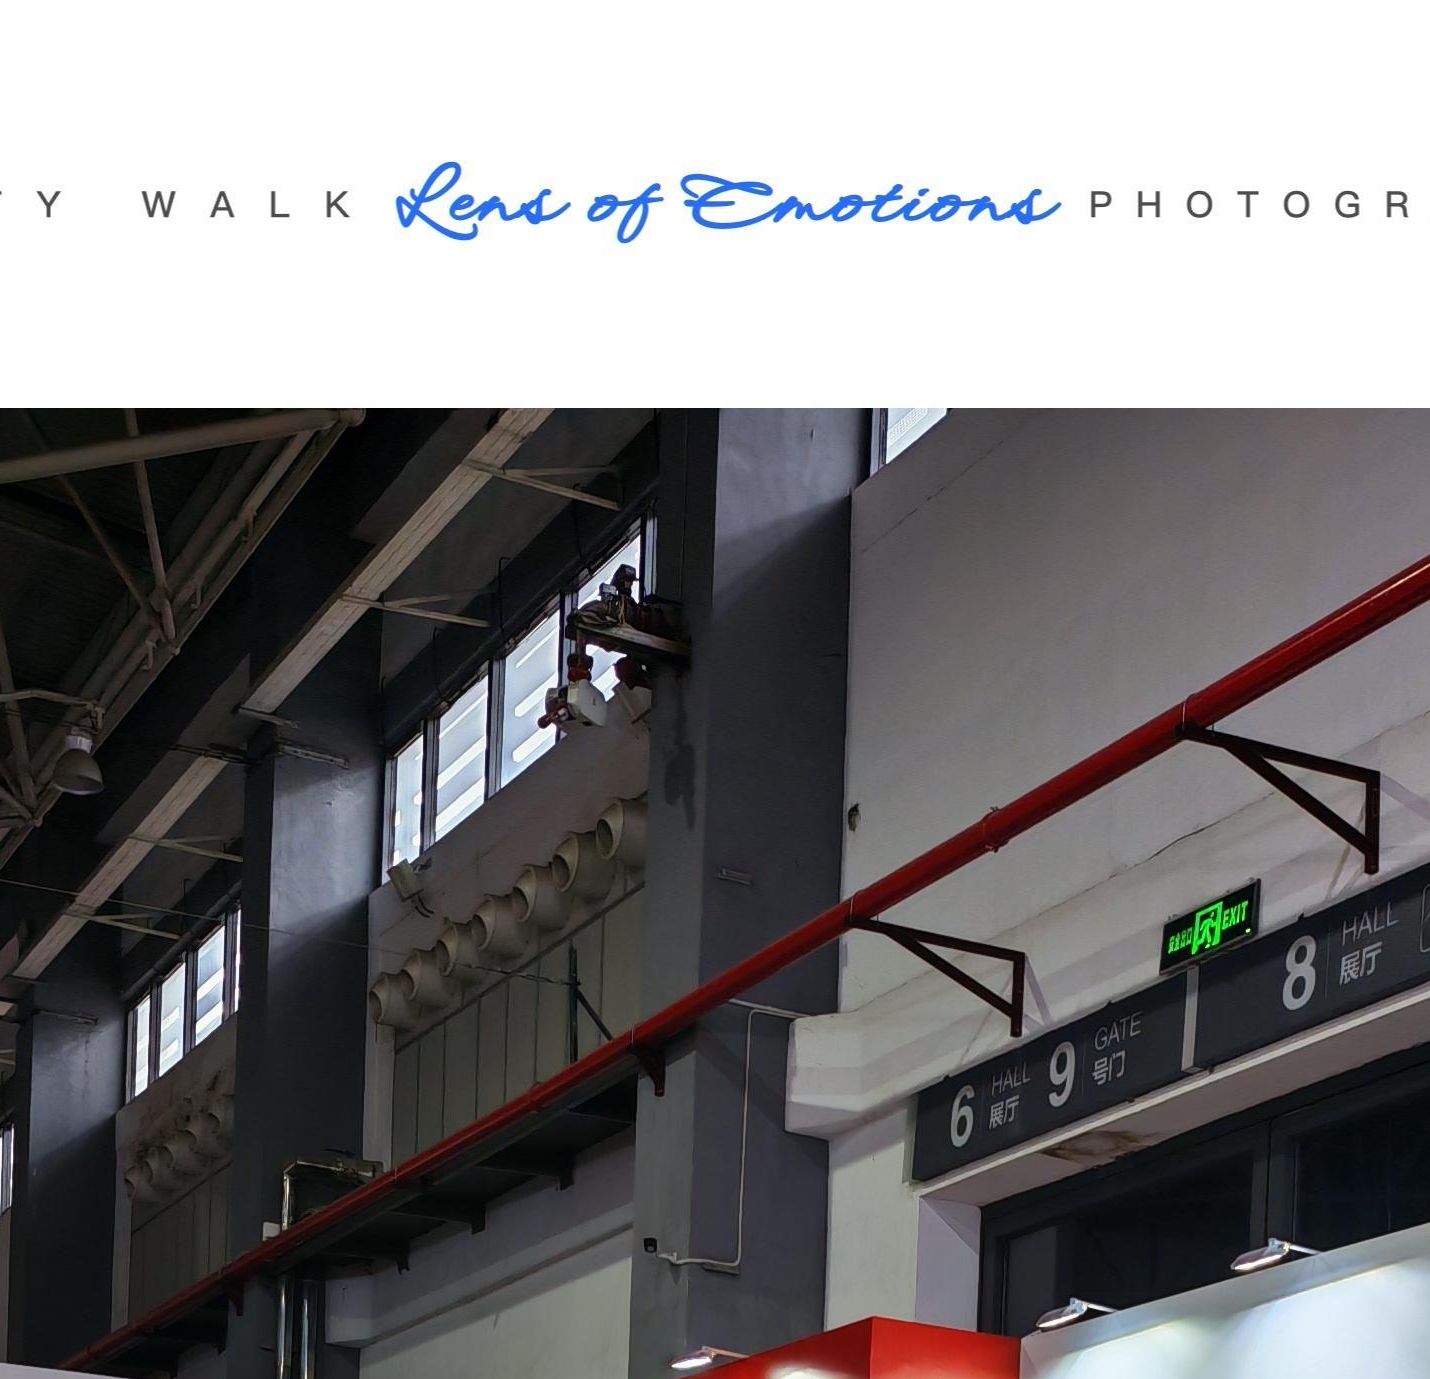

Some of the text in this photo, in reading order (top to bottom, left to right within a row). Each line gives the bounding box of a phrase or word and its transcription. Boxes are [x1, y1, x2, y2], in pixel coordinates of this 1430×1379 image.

[1221, 900, 1249, 930] EXIT
[1341, 900, 1400, 947] HALL
[1282, 934, 1317, 1011] 8
[1338, 941, 1383, 986] 展厅
[1093, 1010, 1143, 1051] GATE
[991, 1060, 1031, 1097] HALL
[1048, 1040, 1076, 1109] 9
[1091, 1049, 1126, 1086] 号门
[950, 1084, 976, 1149] 6
[988, 1094, 1020, 1130] 展厅
